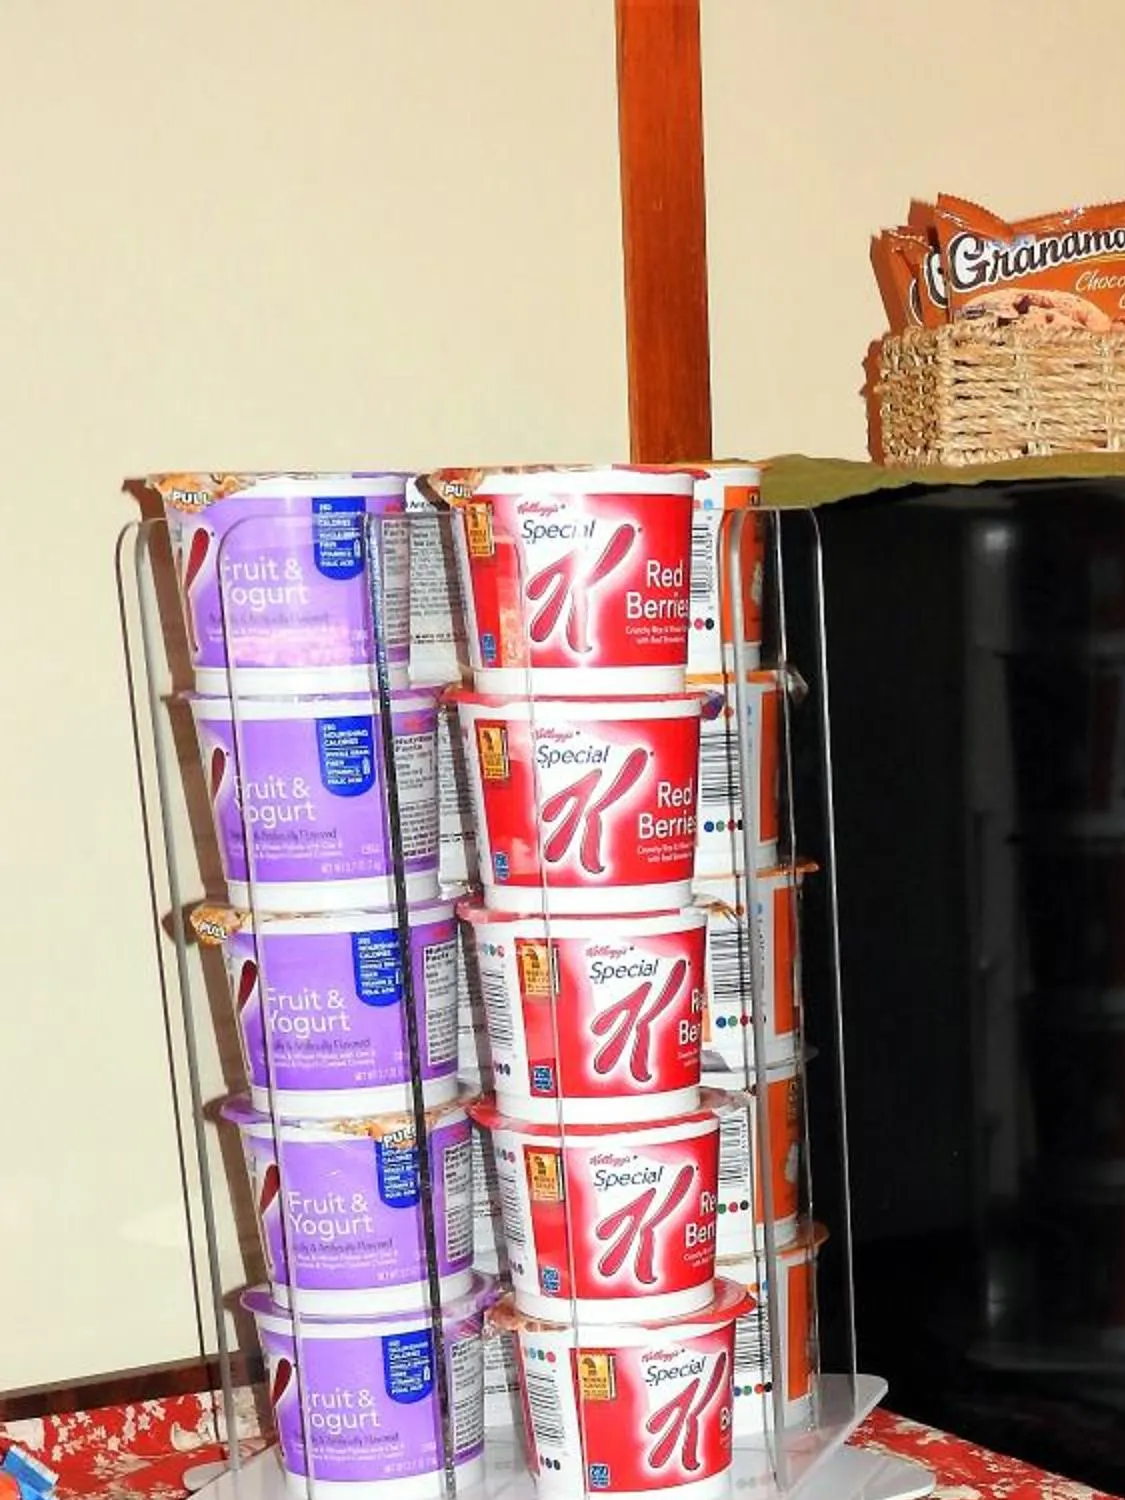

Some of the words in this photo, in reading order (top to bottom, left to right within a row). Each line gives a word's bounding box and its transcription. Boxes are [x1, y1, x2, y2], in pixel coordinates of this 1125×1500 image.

[286, 557, 302, 581] &
[647, 559, 683, 588] Red
[537, 745, 611, 768] Special
[292, 777, 310, 798] &
[657, 778, 693, 808] Red
[589, 959, 659, 984] Special
[266, 987, 322, 1012] Fruit
[327, 989, 345, 1010] &
[594, 1166, 664, 1191] Special
[288, 1191, 345, 1214] Fruit
[351, 1193, 368, 1213] &
[289, 1214, 375, 1242] Yogurt
[645, 1356, 707, 1386] Special
[307, 1387, 355, 1409] ruit
[358, 1389, 374, 1409] &
[307, 1410, 381, 1435] ogurt
